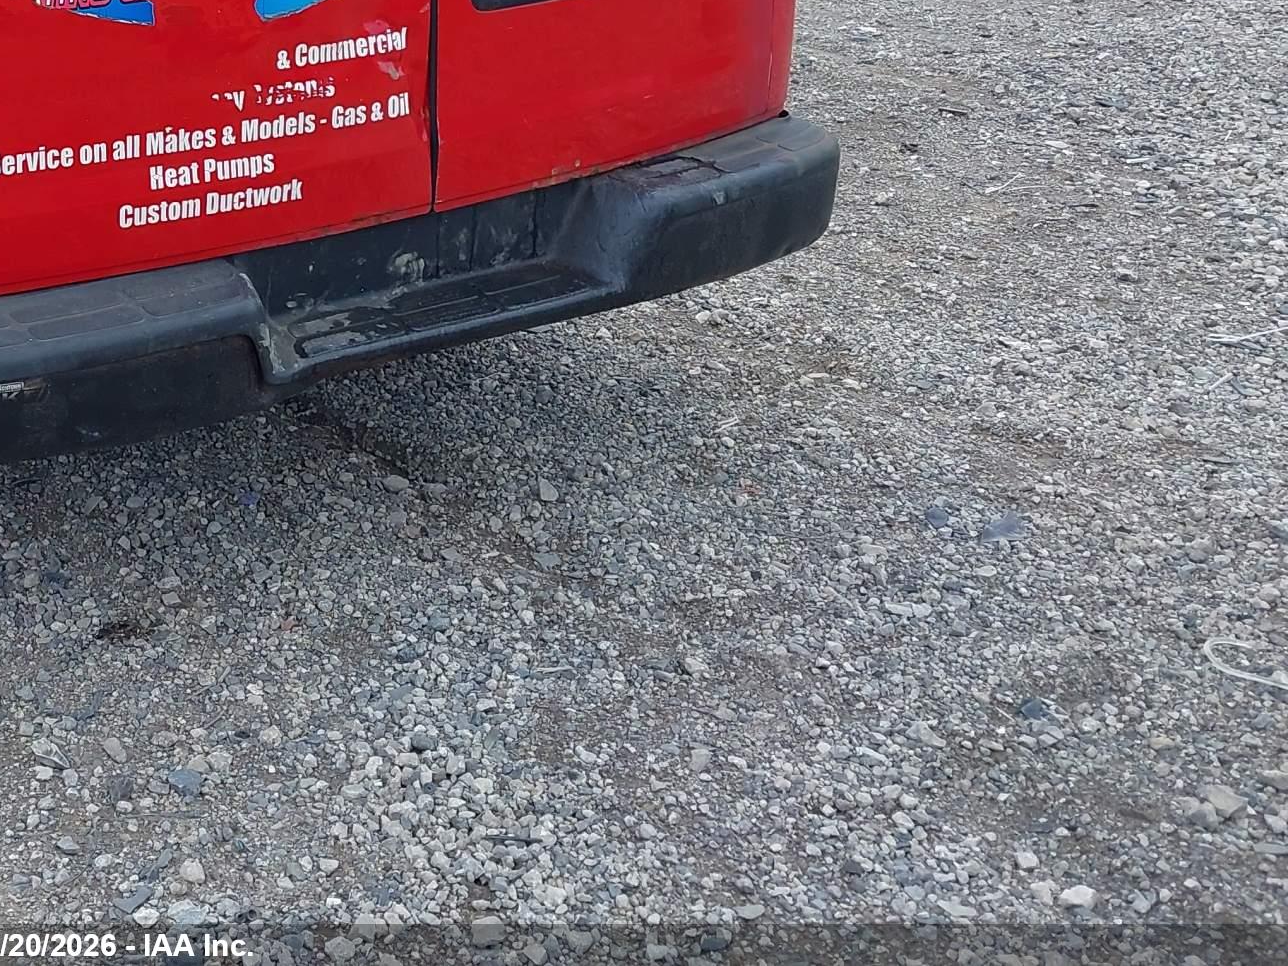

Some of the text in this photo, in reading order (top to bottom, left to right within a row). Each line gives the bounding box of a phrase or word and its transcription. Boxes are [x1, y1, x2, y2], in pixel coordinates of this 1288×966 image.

[276, 26, 409, 70] & Commercial
[79, 142, 107, 165] on
[112, 135, 141, 161] all
[145, 128, 217, 157] Makes
[221, 125, 237, 146] &
[241, 111, 316, 143] Models
[331, 105, 367, 129] Gas
[370, 101, 384, 122] &
[387, 92, 410, 119] Oil
[149, 153, 275, 191] Heat Pumps
[119, 178, 303, 229] Custom Ductwork
